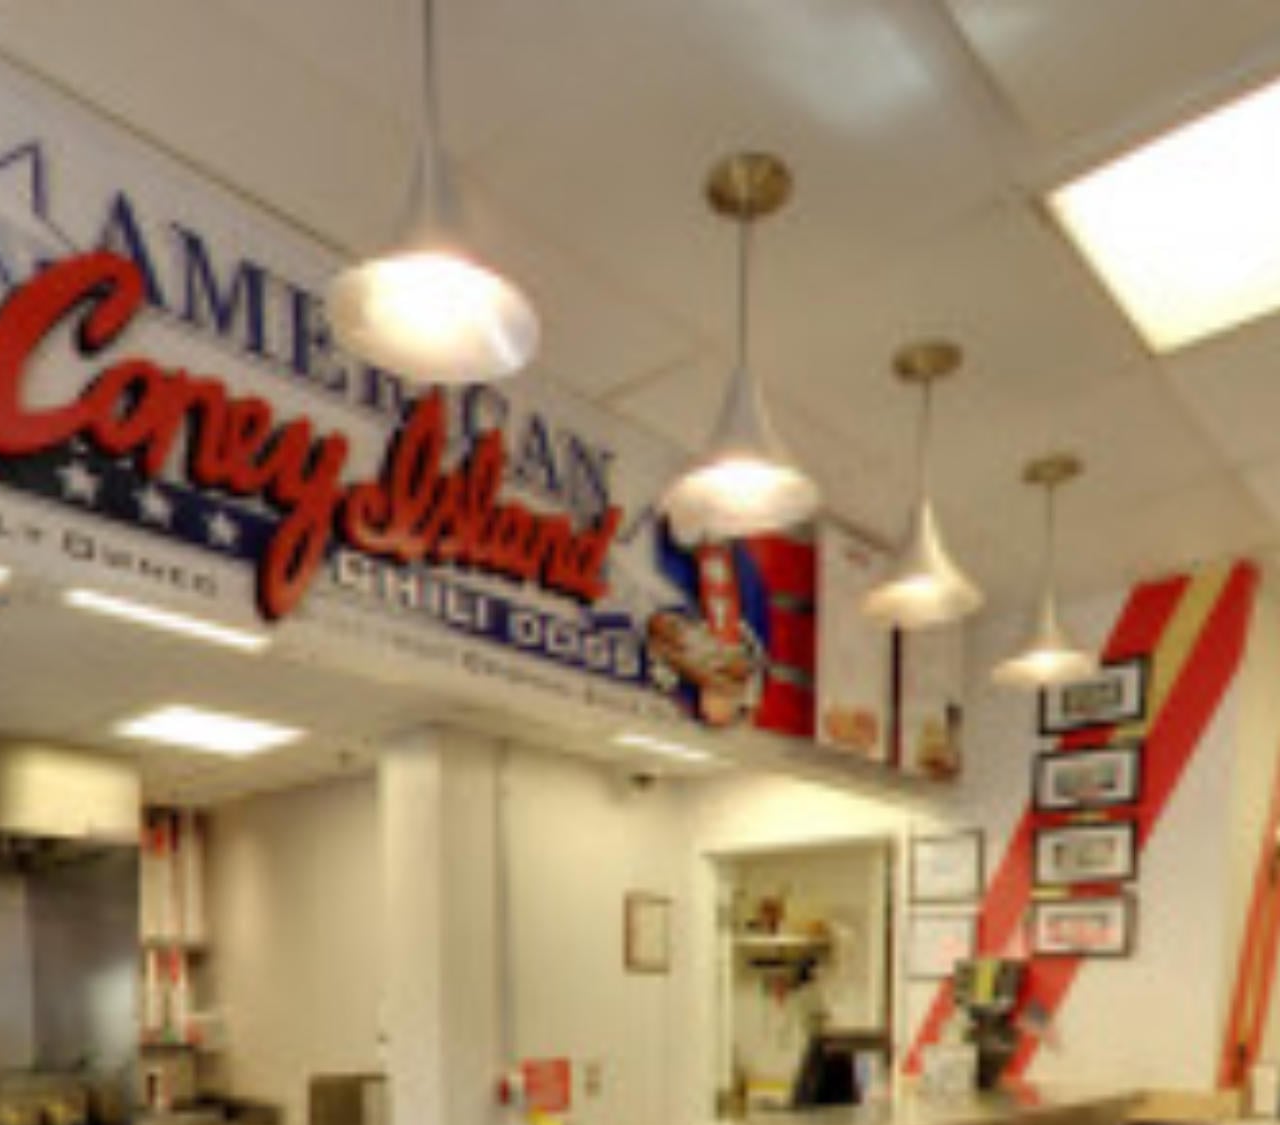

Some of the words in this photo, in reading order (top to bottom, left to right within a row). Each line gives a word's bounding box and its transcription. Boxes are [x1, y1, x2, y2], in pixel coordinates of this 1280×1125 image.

[92, 188, 615, 522] AMECAN
[332, 546, 492, 630] CHILI
[336, 382, 624, 604] Island
